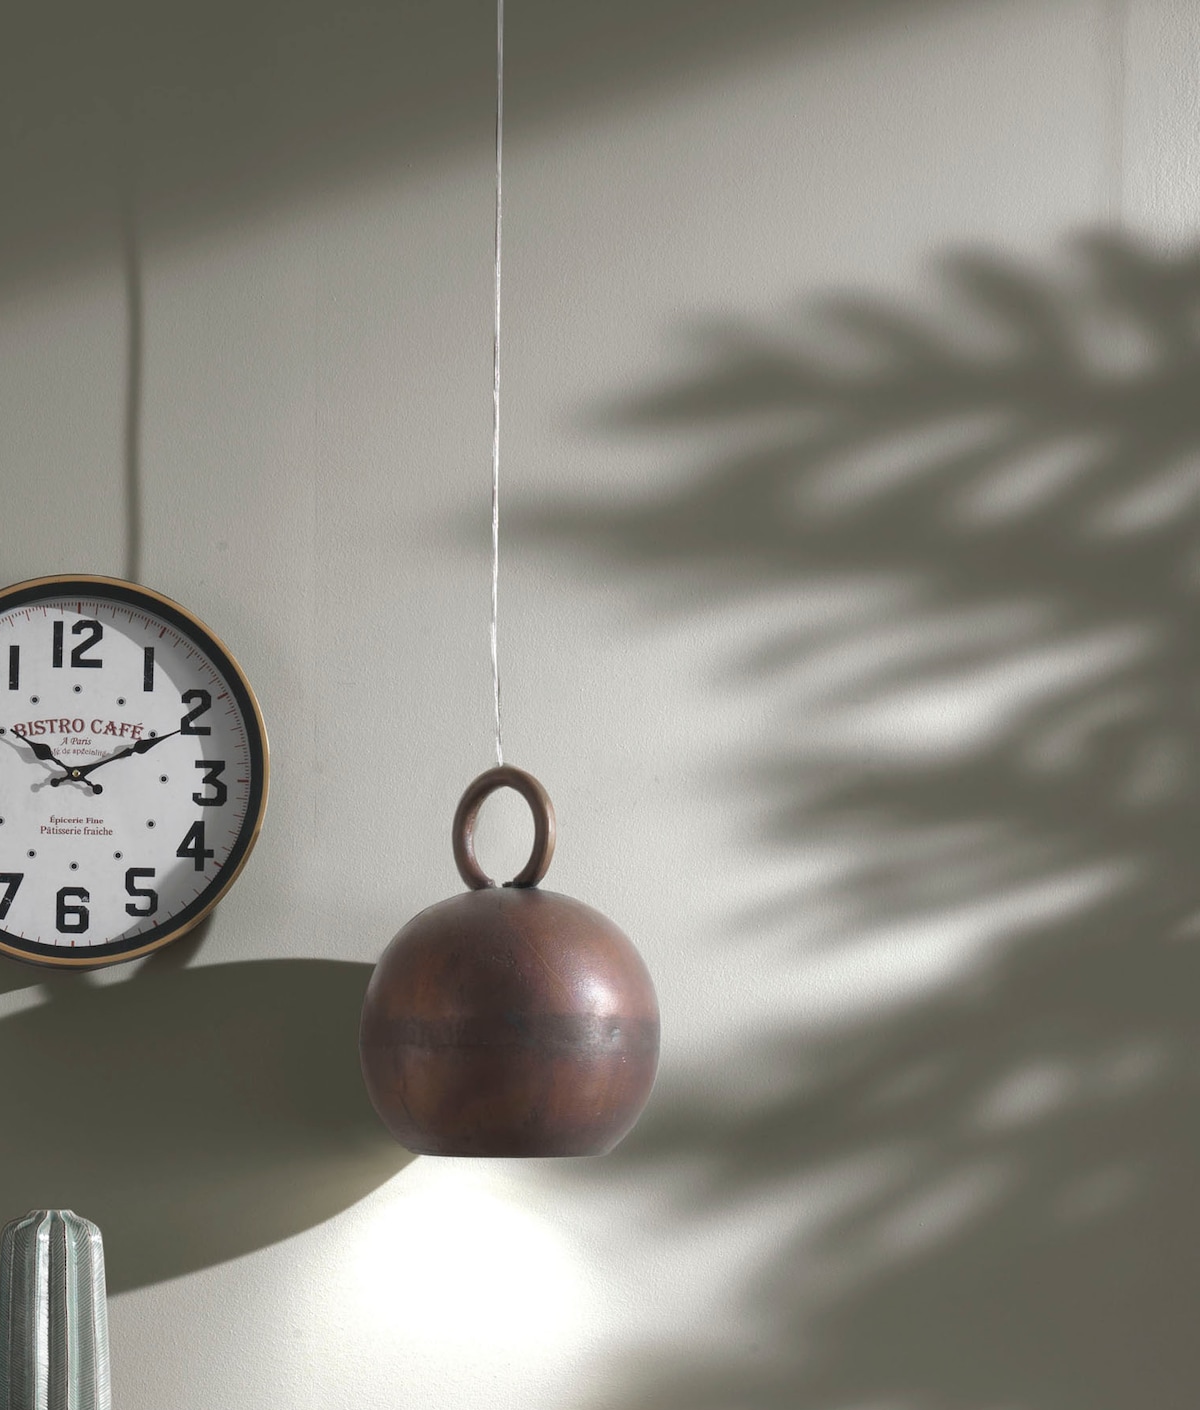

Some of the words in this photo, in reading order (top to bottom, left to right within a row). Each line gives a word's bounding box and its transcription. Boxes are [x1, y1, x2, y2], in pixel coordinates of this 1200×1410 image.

[52, 619, 103, 668] 12
[143, 646, 155, 692] 1
[13, 718, 85, 738] BISTRO
[90, 719, 144, 740] CAFÉ
[180, 689, 212, 736] 2
[70, 736, 93, 746] Paris
[192, 760, 227, 806] 3
[176, 820, 215, 872] 4
[55, 886, 90, 934] 6
[124, 867, 159, 917] 5
